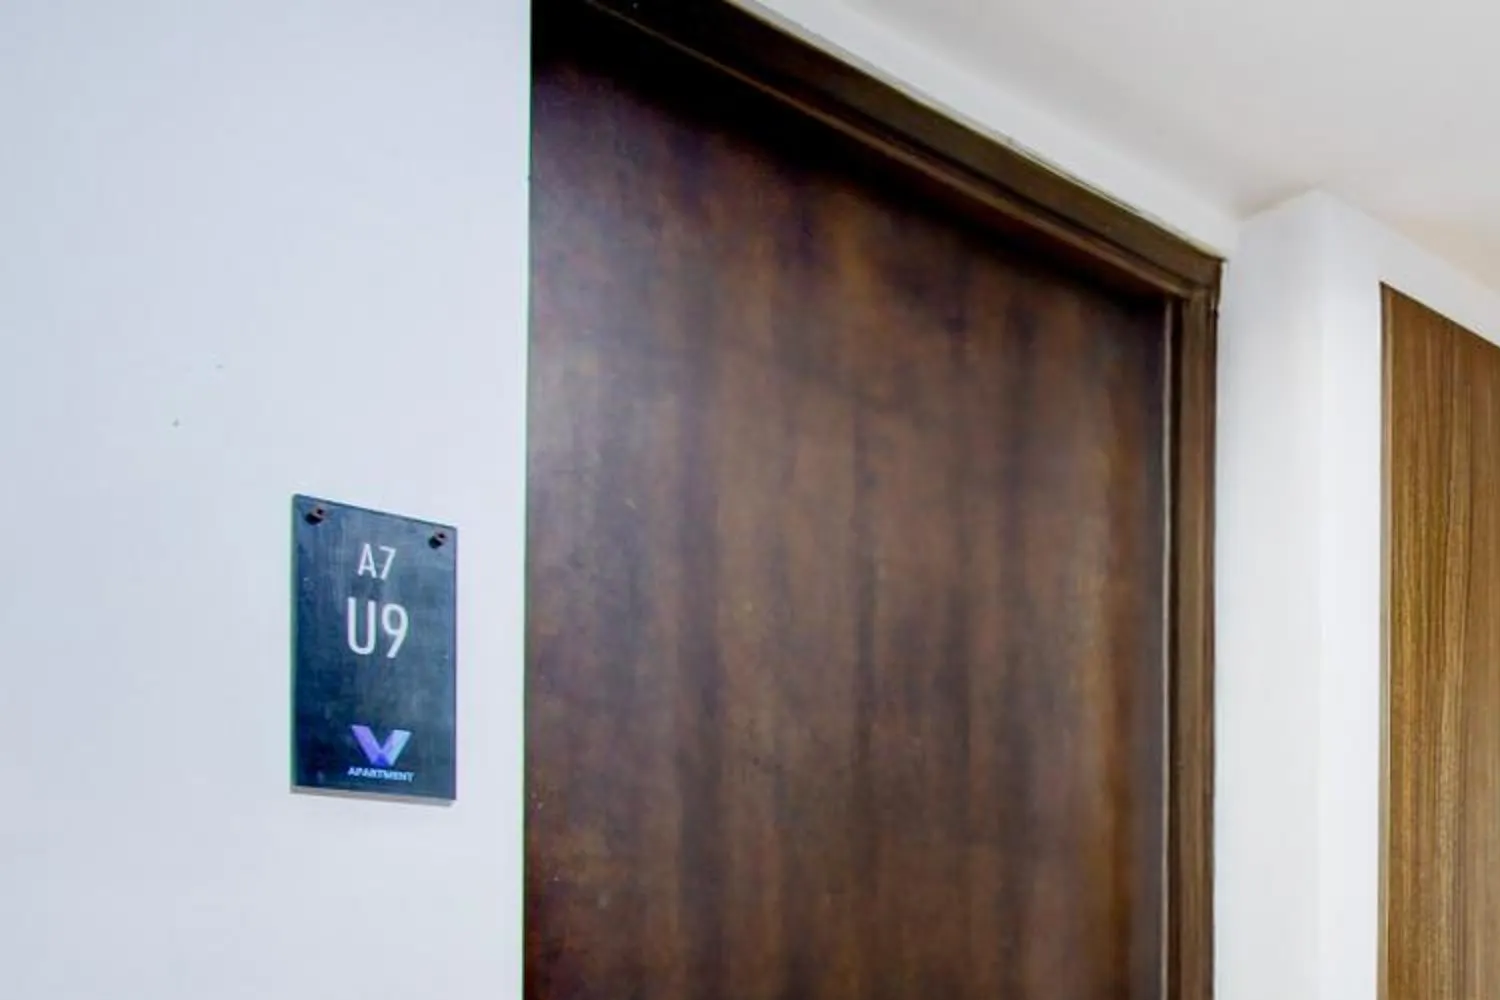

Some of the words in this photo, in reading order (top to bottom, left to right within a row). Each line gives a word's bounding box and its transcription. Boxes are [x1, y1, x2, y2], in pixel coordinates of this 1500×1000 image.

[357, 542, 396, 580] A7
[347, 597, 409, 659] U9
[347, 767, 414, 782] APARTMENT
